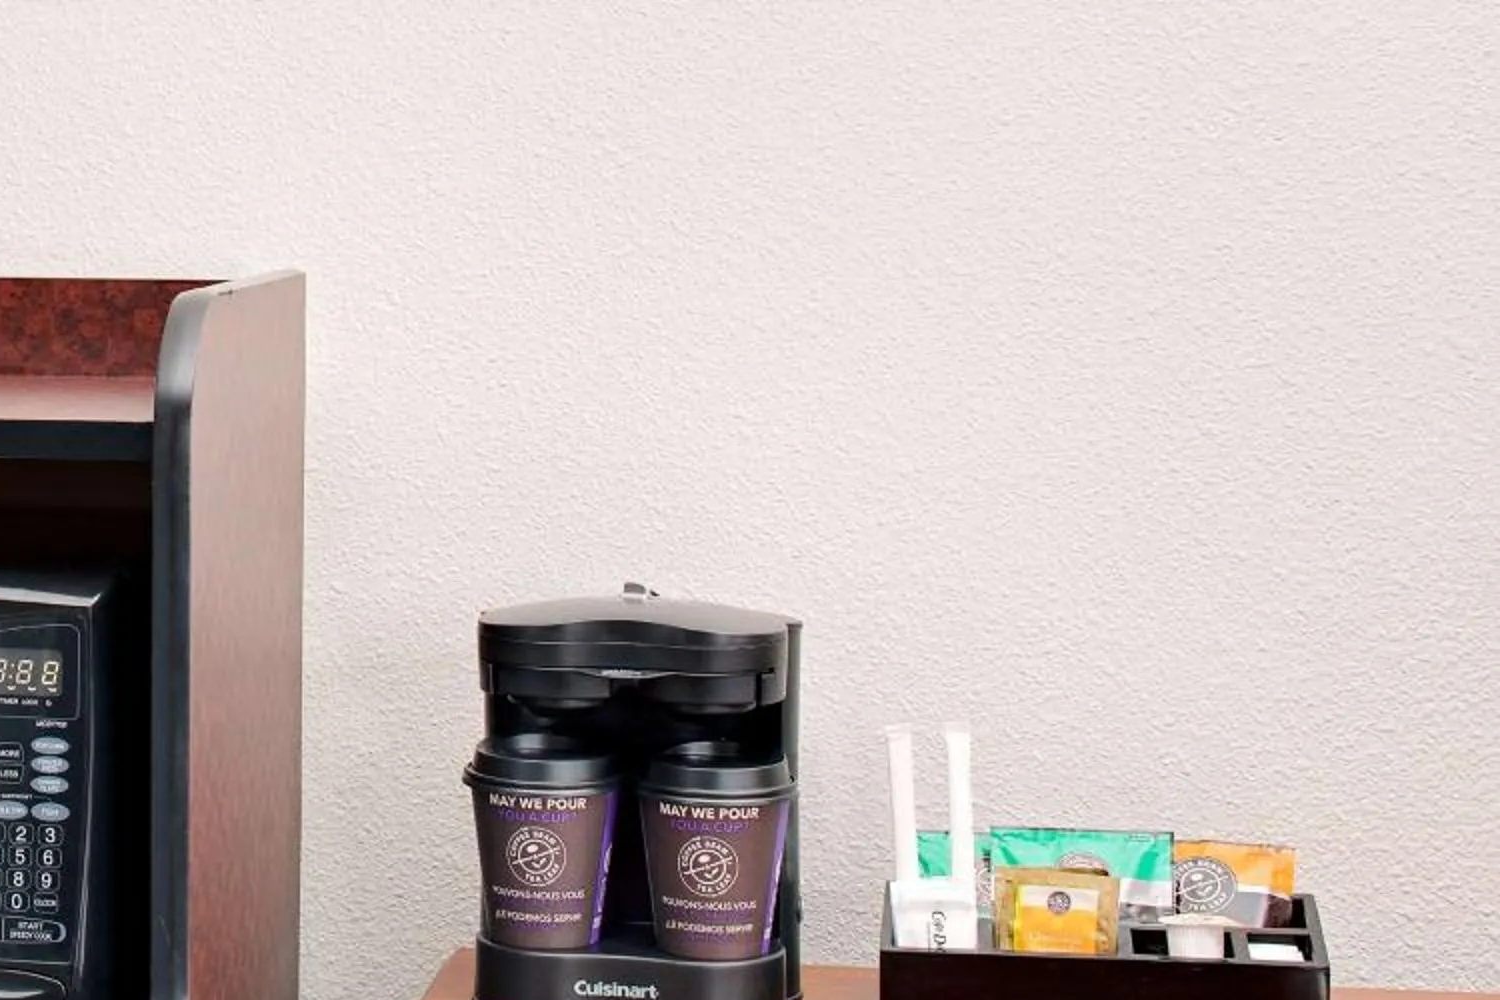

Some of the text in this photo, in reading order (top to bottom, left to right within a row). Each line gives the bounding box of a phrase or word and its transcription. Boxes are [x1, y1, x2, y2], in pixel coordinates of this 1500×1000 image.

[489, 793, 587, 810] MAY WE POUR
[660, 802, 760, 820] MAY WE POUR
[15, 826, 27, 842] 2
[45, 827, 56, 843] 3
[15, 848, 25, 864] 5
[43, 850, 53, 865] 6
[13, 871, 24, 887] 8
[41, 873, 52, 888] 9
[11, 893, 22, 909] 0
[18, 921, 43, 931] START
[573, 979, 657, 1000] Cuisinart
